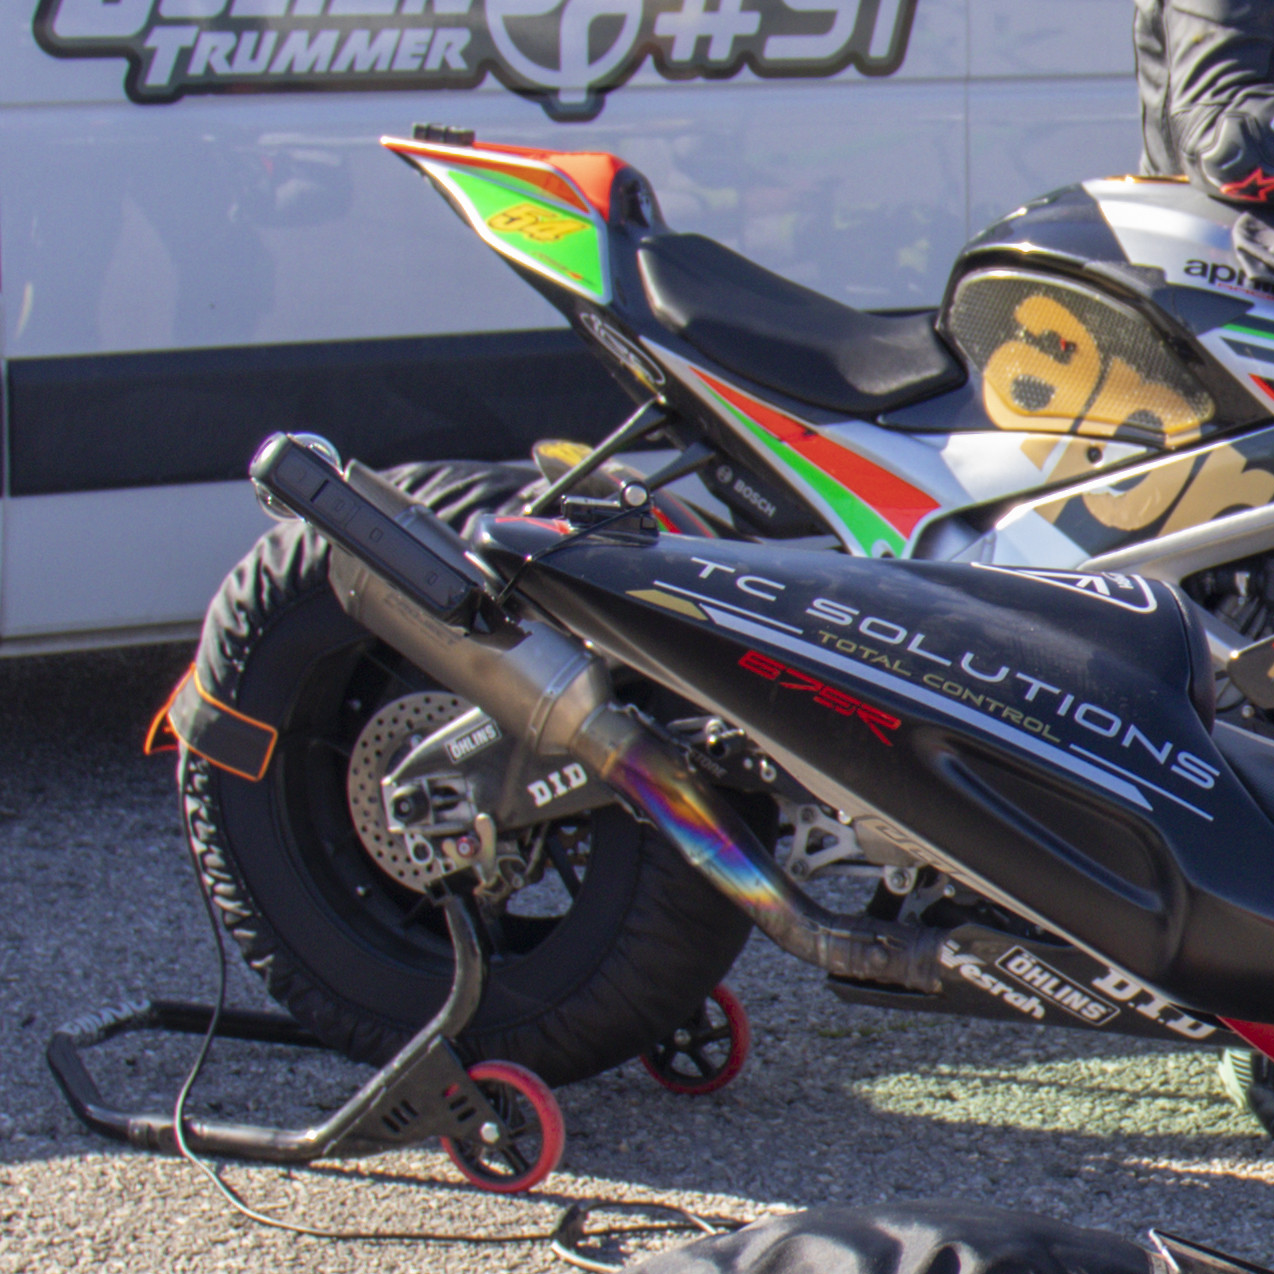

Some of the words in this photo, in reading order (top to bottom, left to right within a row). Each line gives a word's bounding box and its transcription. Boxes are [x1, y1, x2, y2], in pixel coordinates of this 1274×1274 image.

[144, 26, 471, 87] TRUMMER
[486, 203, 592, 243] 54
[733, 477, 777, 517] BOSCH
[690, 555, 787, 602] TC
[805, 597, 1221, 790] SOLUTIONS
[817, 629, 913, 677] TOTAL
[922, 672, 1062, 744] CONTROL
[940, 938, 1046, 1020] Vesrah
[1006, 952, 1107, 1021] ÖHLINS
